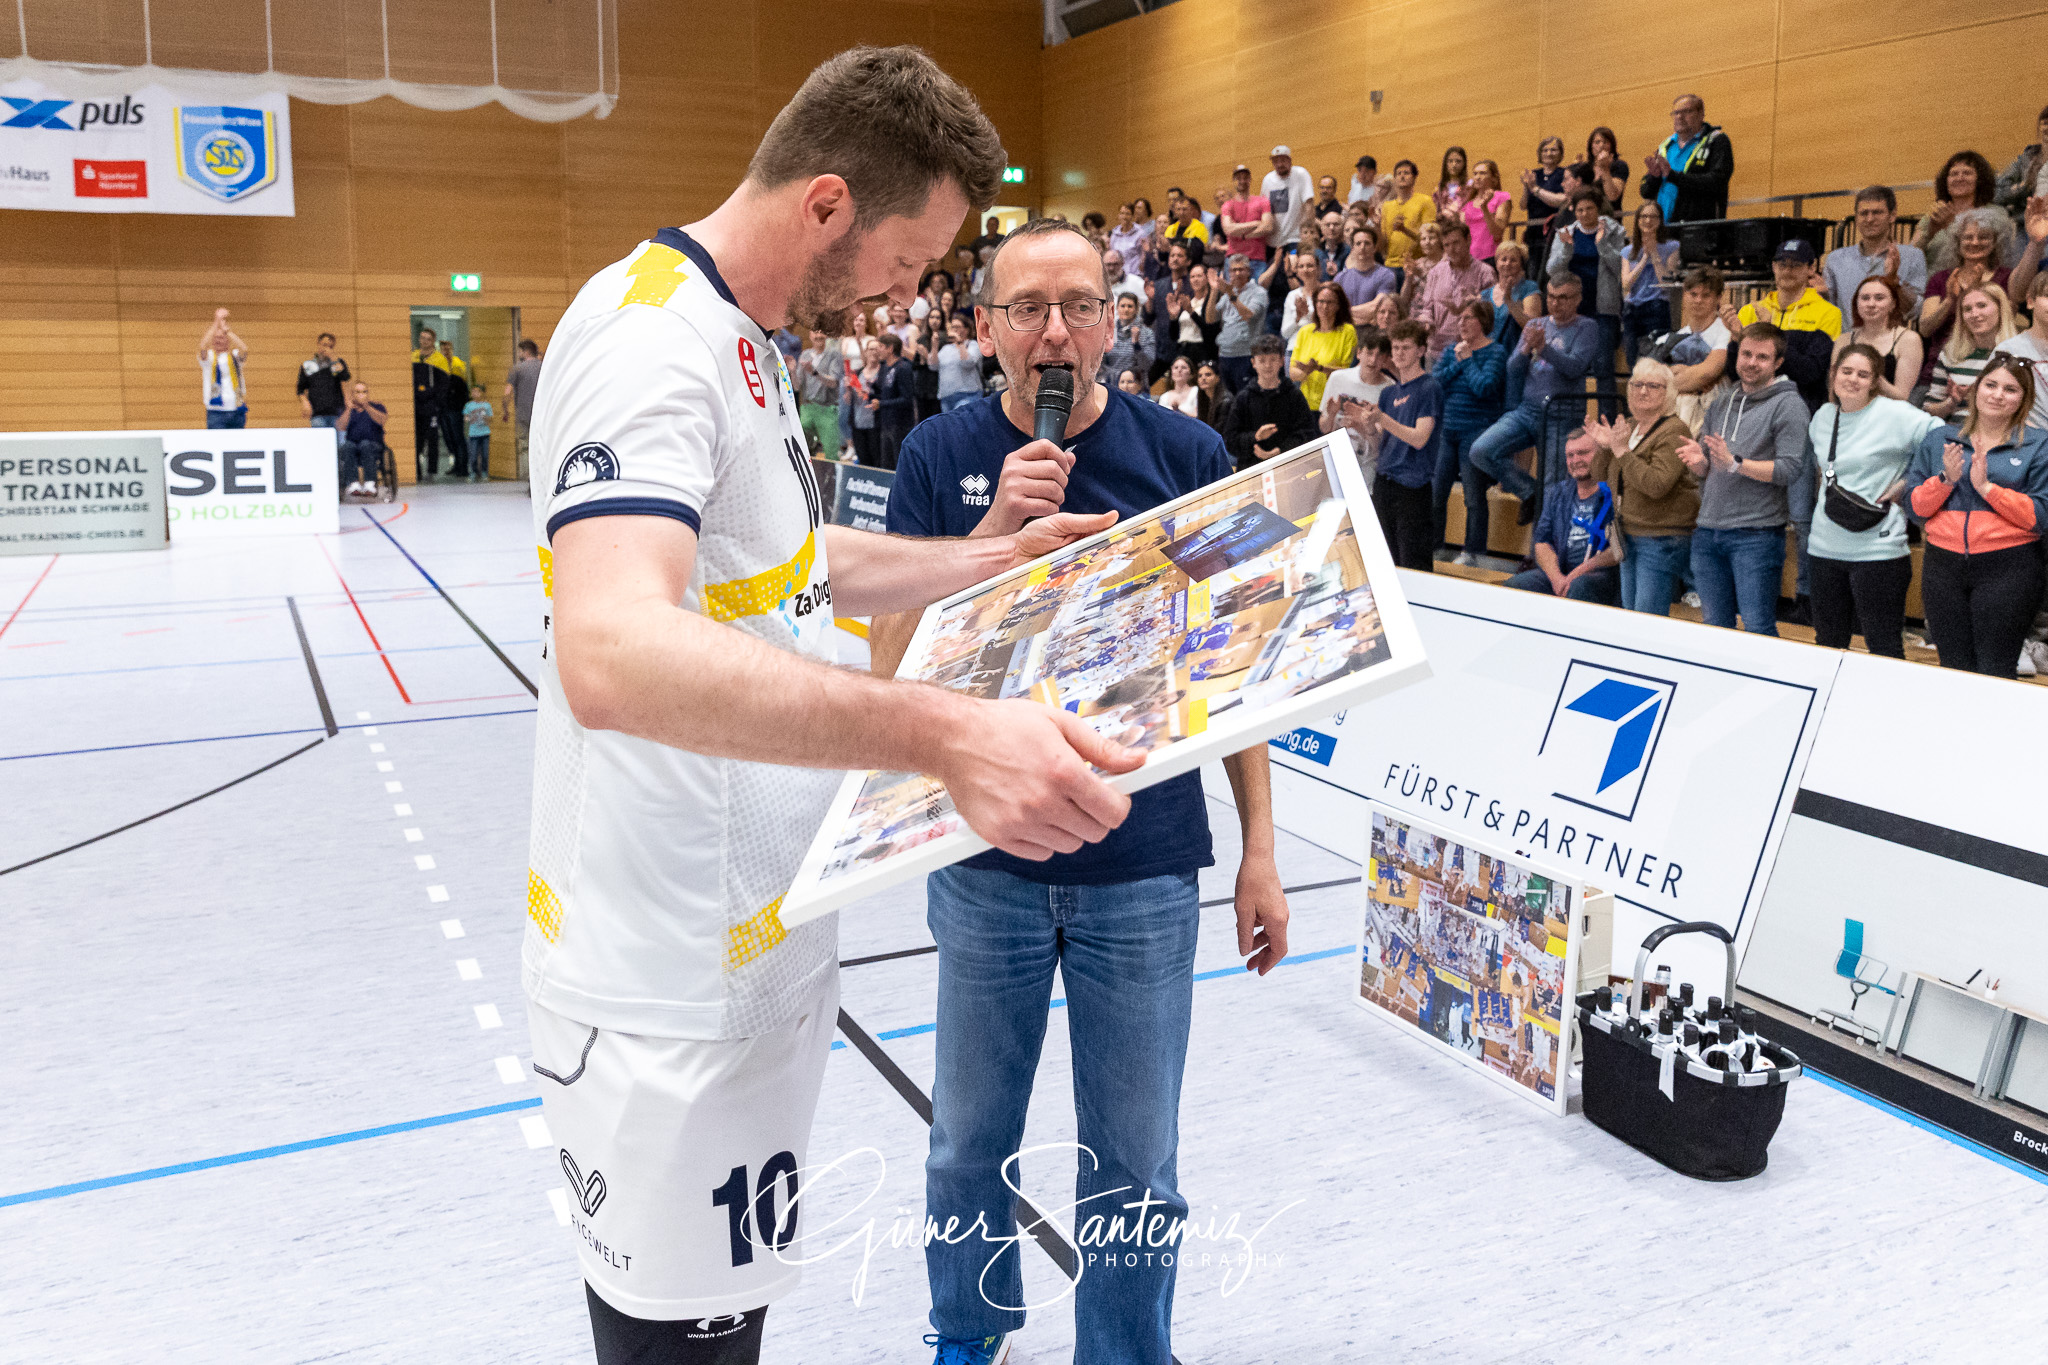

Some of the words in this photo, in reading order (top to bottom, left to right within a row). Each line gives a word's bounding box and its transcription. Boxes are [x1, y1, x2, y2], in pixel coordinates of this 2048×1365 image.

[79, 95, 145, 131] puls
[0, 456, 148, 476] PERSONAL
[163, 450, 312, 497] SEL
[3, 481, 145, 501] TRAINING
[191, 503, 312, 521] HOLZBAU
[1273, 731, 1320, 755] ung.de
[712, 1150, 799, 1268] 10
